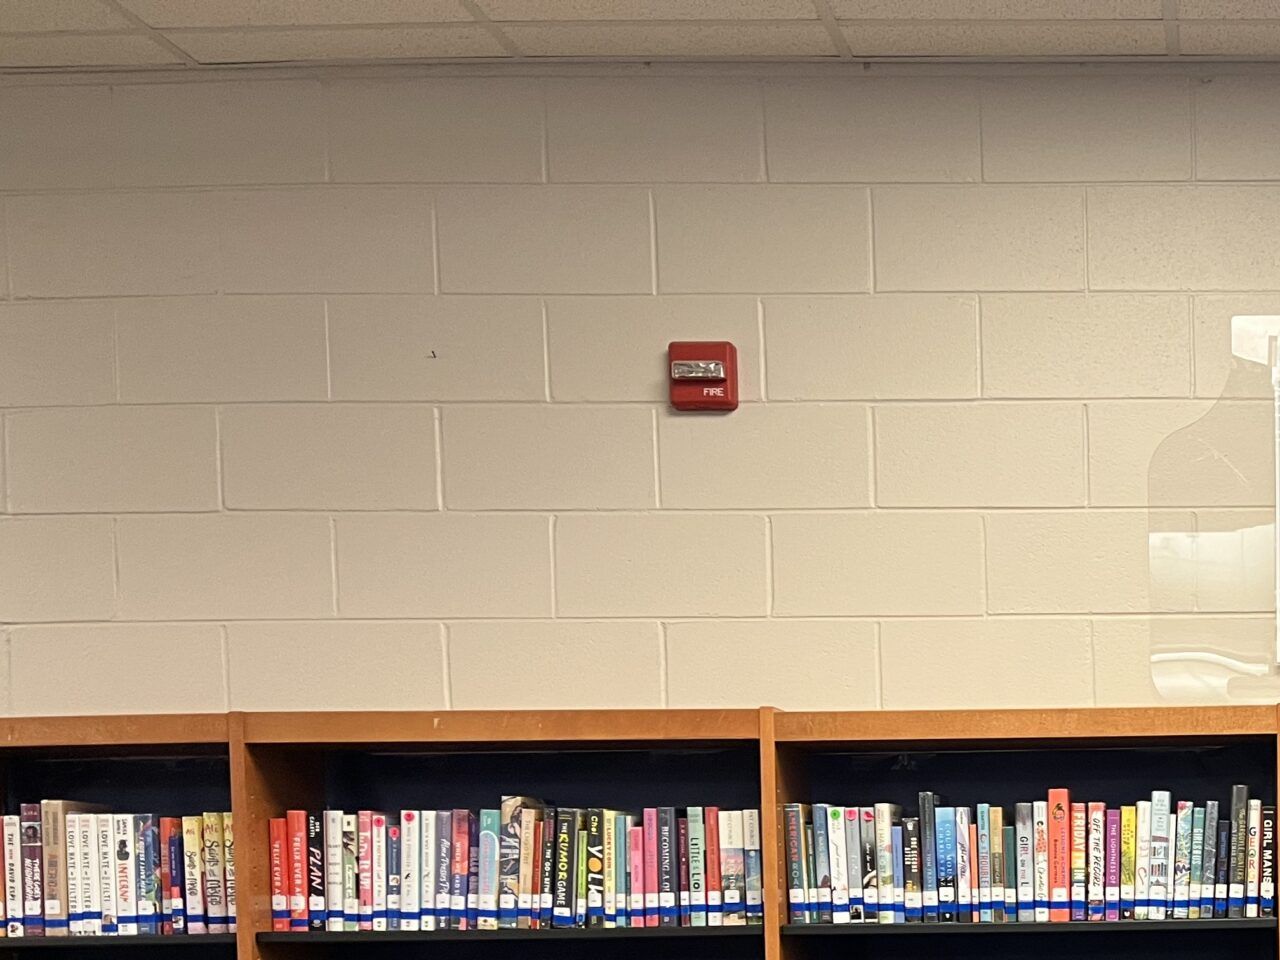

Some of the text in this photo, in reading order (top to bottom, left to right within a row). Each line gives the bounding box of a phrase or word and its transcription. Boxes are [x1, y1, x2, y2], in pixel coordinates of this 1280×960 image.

[704, 388, 724, 396] FIRE
[661, 826, 669, 872] BECOMING
[691, 837, 699, 863] LITTLE
[789, 811, 798, 861] AMERICAN
[1020, 837, 1028, 857] GIRL
[1074, 813, 1084, 879] FRIDAY IN
[1263, 820, 1272, 846] GIRL
[310, 847, 323, 889] PLAN
[558, 834, 569, 880] RUMOR
[557, 881, 566, 905] GAME
